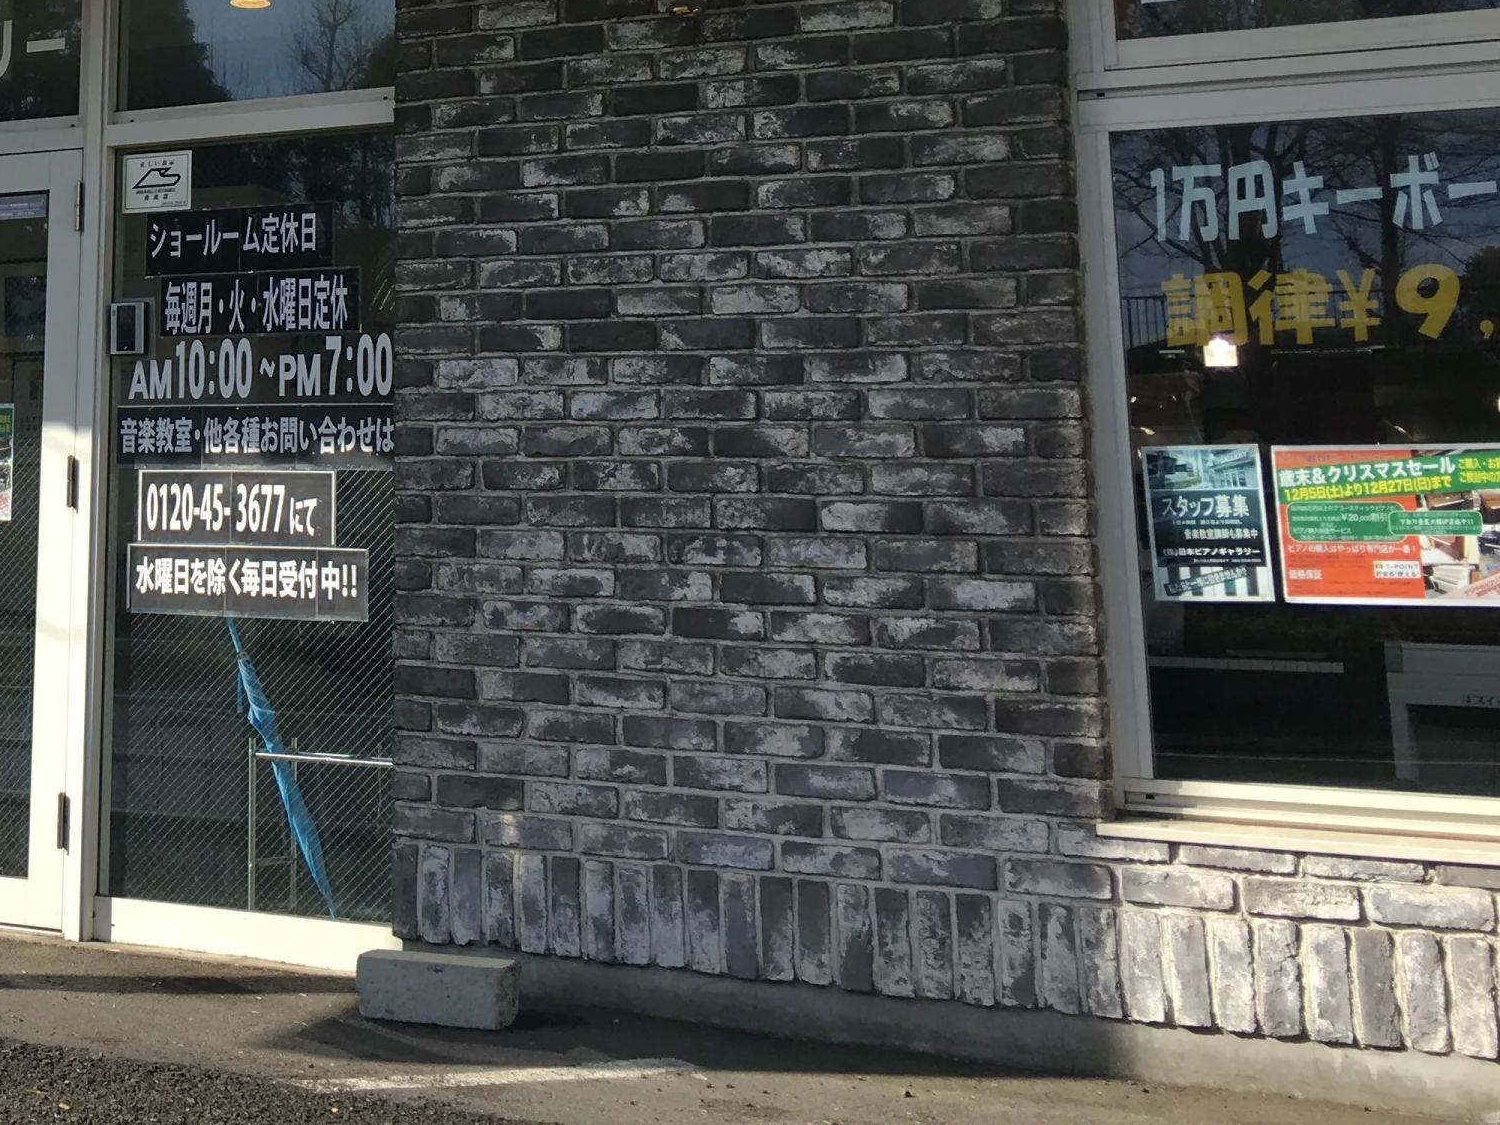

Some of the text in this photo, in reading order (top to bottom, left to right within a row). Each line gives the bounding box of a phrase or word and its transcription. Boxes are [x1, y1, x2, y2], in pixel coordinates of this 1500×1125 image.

[150, 212, 317, 259] ショールーム定休日
[164, 274, 349, 336] 毎週月・火・水曜日定休
[120, 415, 394, 455] 音楽教室・他各種お問い合わせは
[1278, 457, 1456, 488] 歳末&クリスマスセール
[1162, 494, 1250, 518] スタッフ募集
[135, 556, 358, 601] 水曜日を除く毎日受付中!!
